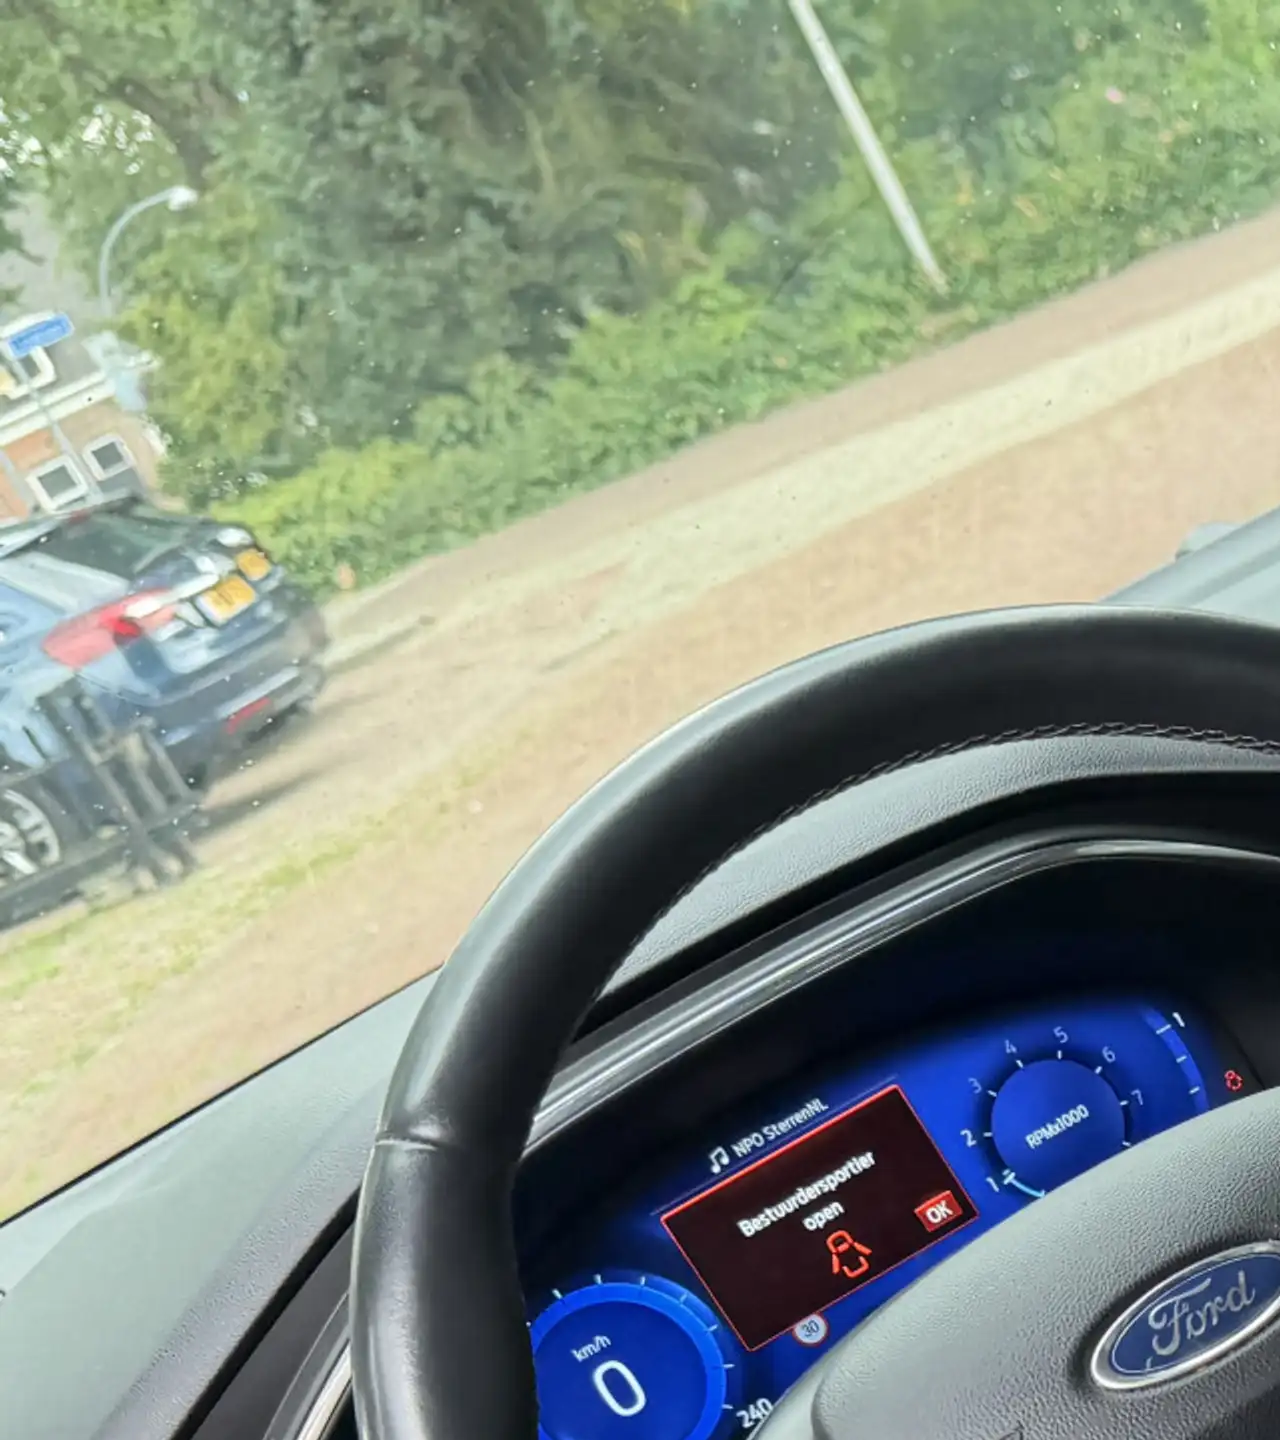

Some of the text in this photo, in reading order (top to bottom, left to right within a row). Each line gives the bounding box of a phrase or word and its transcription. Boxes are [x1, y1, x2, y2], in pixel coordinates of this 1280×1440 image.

[960, 1129, 976, 1147] 2
[968, 1078, 981, 1094] 3
[1004, 1040, 1017, 1054] 4
[1053, 1026, 1068, 1043] 5
[1102, 1046, 1116, 1063] 6
[1131, 1089, 1144, 1105] 7
[1024, 1104, 1090, 1150] RPMx1000
[731, 1133, 764, 1157] NPO
[737, 1151, 877, 1238] Bestuurdersportier
[802, 1201, 845, 1231] open
[925, 1200, 954, 1224] OK
[1148, 1270, 1256, 1356] Ford
[802, 1320, 820, 1338] 30
[570, 1335, 612, 1362] km/h
[592, 1359, 647, 1417] 0
[736, 1398, 774, 1428] 240
